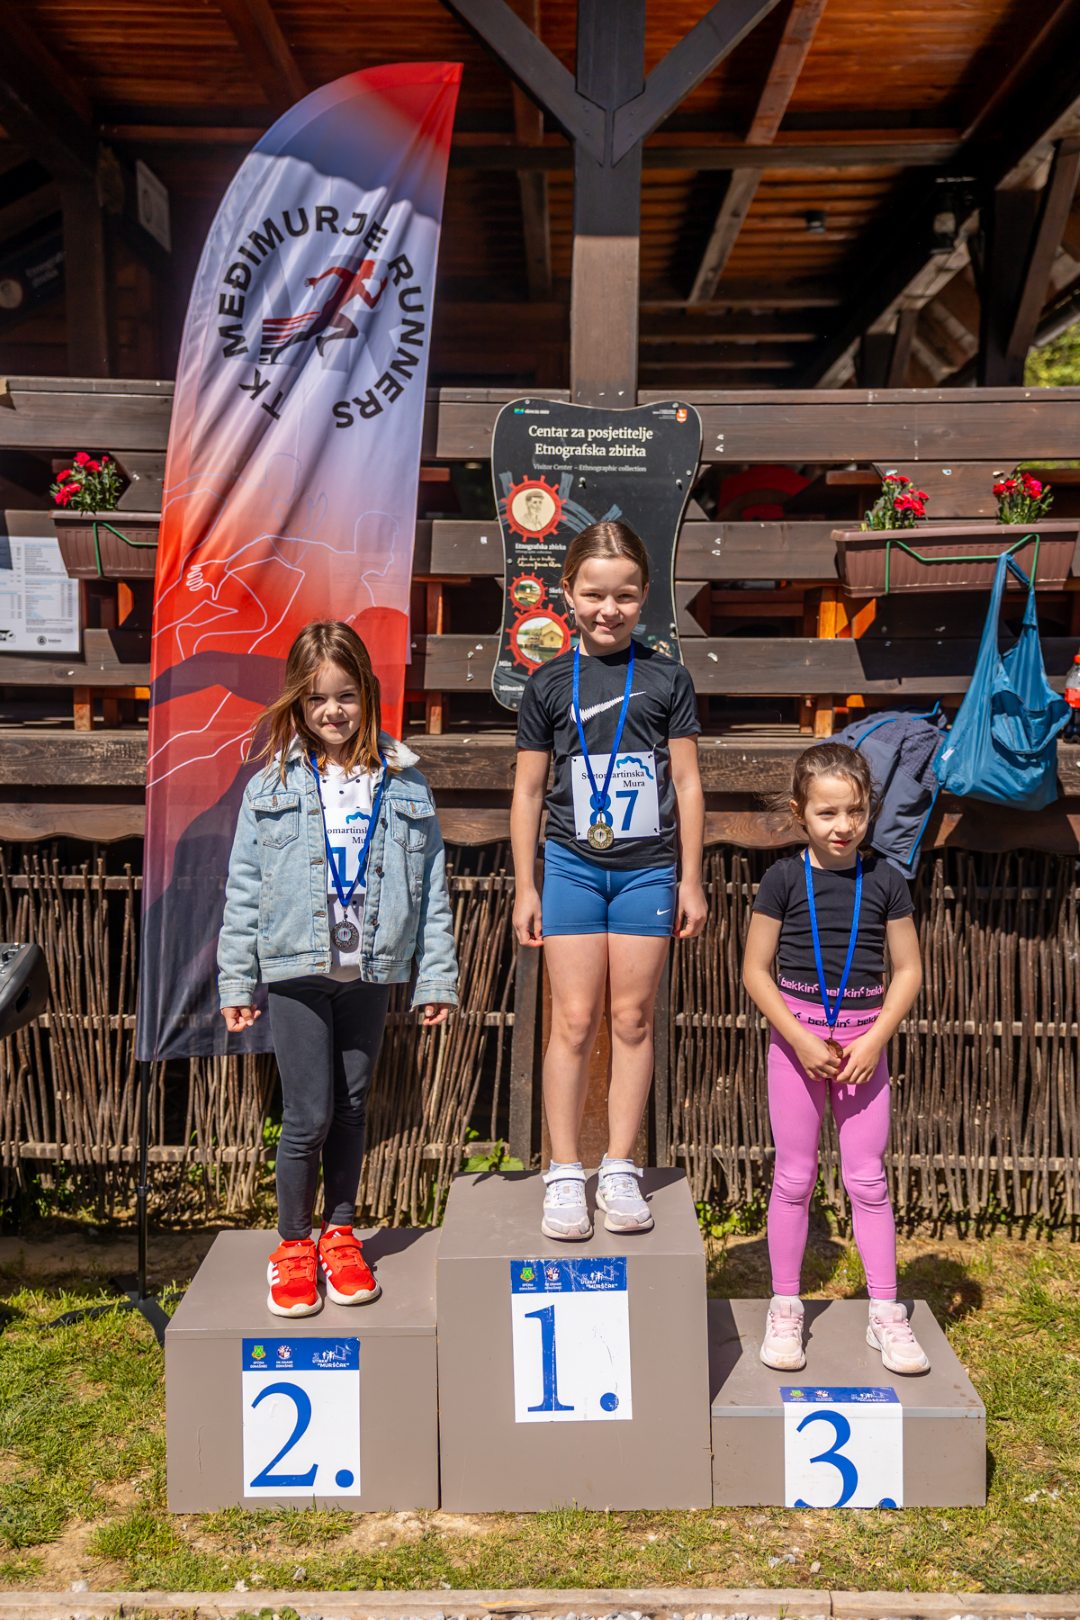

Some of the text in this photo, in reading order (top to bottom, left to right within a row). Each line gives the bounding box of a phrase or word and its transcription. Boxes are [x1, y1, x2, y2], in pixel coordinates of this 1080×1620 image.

[218, 205, 425, 429] TK MEĐIMURJE RUNNERS
[528, 425, 653, 442] Centar za posjetitelje
[534, 443, 647, 459] Etnografska zbirka
[553, 463, 573, 471] Center
[578, 464, 617, 473] Ethnographic
[581, 769, 645, 780] Stoartinska
[623, 779, 645, 788] Mura
[589, 790, 639, 831] 87
[524, 1304, 620, 1412] 1.
[250, 1381, 355, 1488] 2.
